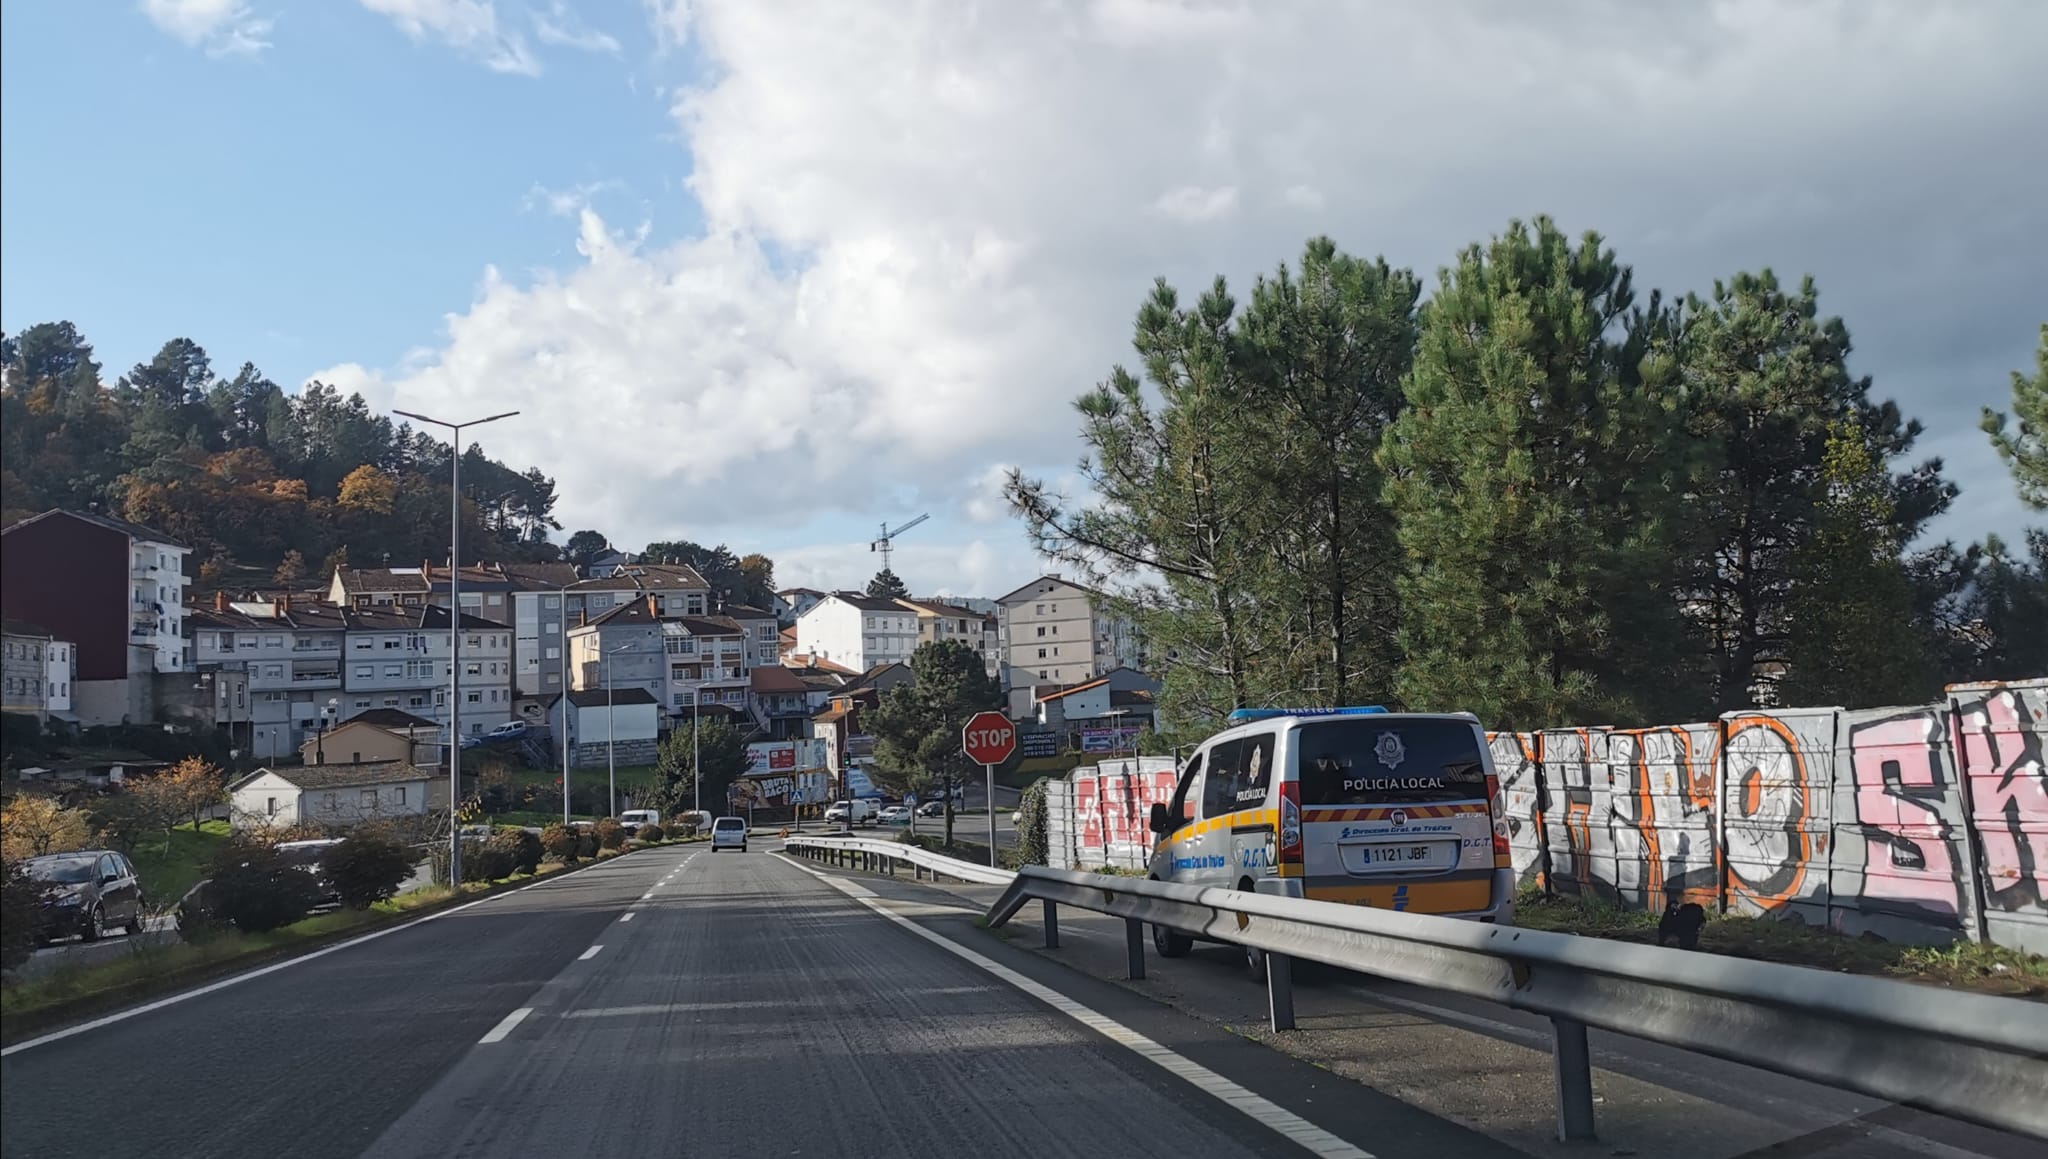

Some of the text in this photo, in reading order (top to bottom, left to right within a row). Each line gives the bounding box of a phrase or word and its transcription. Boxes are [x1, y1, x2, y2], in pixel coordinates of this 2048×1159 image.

[968, 728, 1012, 748] STOP
[1344, 776, 1445, 791] POLICÍA LOCAL
[1253, 787, 1266, 799] LOCAL
[1463, 838, 1491, 848] D.G.T.
[1375, 846, 1429, 862] 1121 JBF
